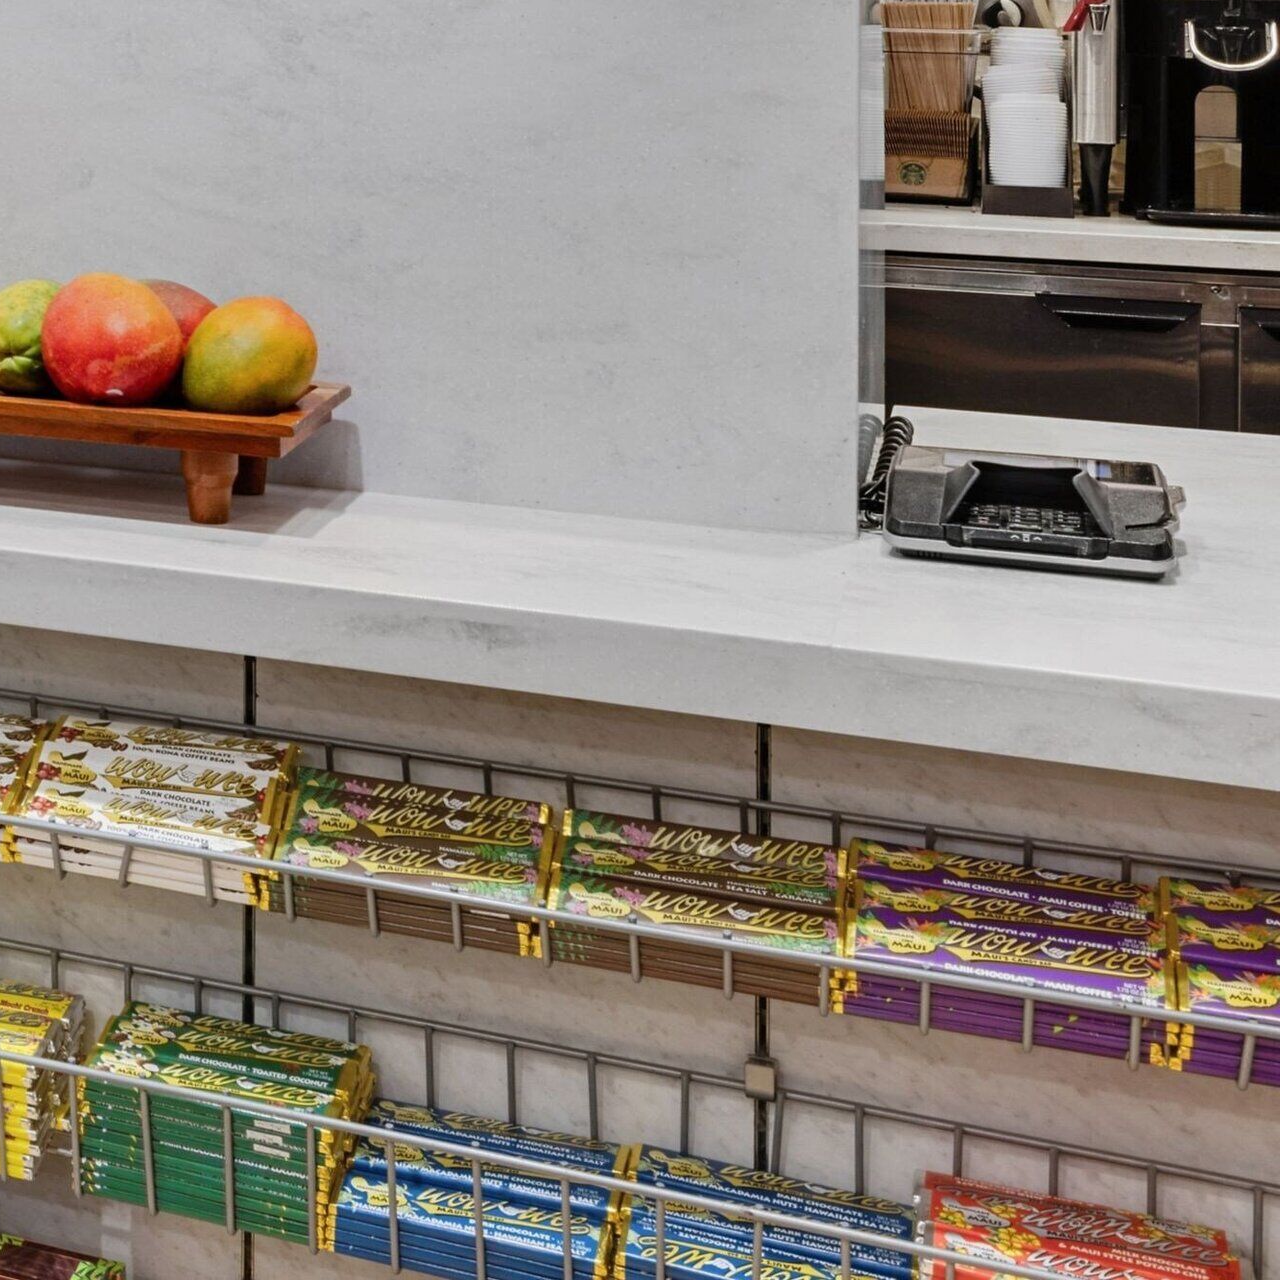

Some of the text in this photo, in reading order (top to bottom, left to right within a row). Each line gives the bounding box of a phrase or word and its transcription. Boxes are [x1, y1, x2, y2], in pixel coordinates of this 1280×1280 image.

[63, 772, 90, 781] MAUI
[140, 789, 211, 807] DARK CHOCOLATE
[634, 870, 823, 905] DARK CHOCOLATE SEA SALT CARAMEL
[943, 878, 1147, 920] DARK CHOCOLATE MAUI COFFEE TOFFEE
[892, 941, 927, 951] MAUI
[179, 1053, 329, 1088] DARK CHOCOLATE TOASTED COCONUT
[709, 1182, 770, 1202] MACADAMIA
[772, 1199, 798, 1210] NUTS
